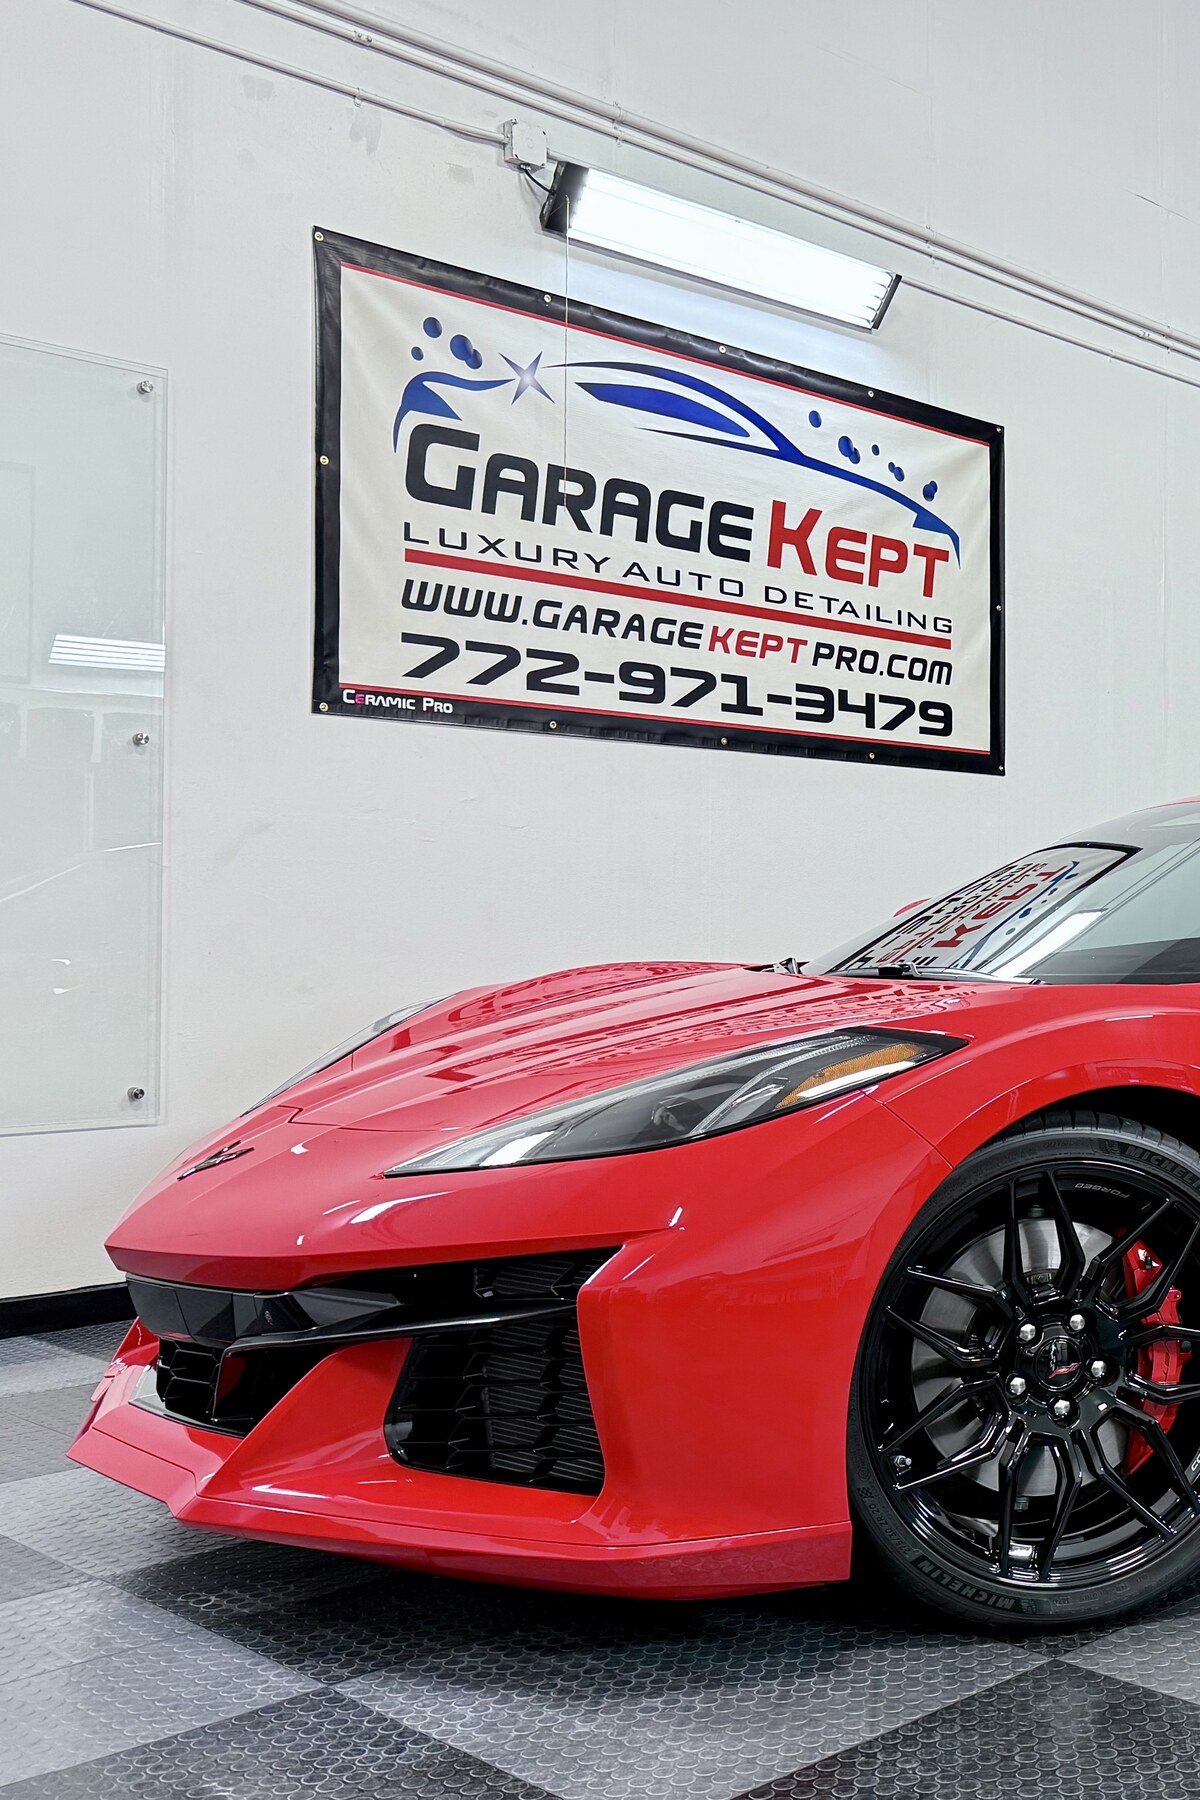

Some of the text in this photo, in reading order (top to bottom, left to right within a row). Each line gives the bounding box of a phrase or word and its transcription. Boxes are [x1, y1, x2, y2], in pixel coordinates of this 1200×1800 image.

[405, 423, 949, 598] GARAGE KEPT
[404, 522, 952, 633] LUXURY AUTO DETAILING
[343, 689, 416, 710] CERAMIC
[401, 632, 953, 737] 772-971-3479
[1074, 1182, 1130, 1199] FORGED
[918, 1561, 1015, 1611] MICHELIN
